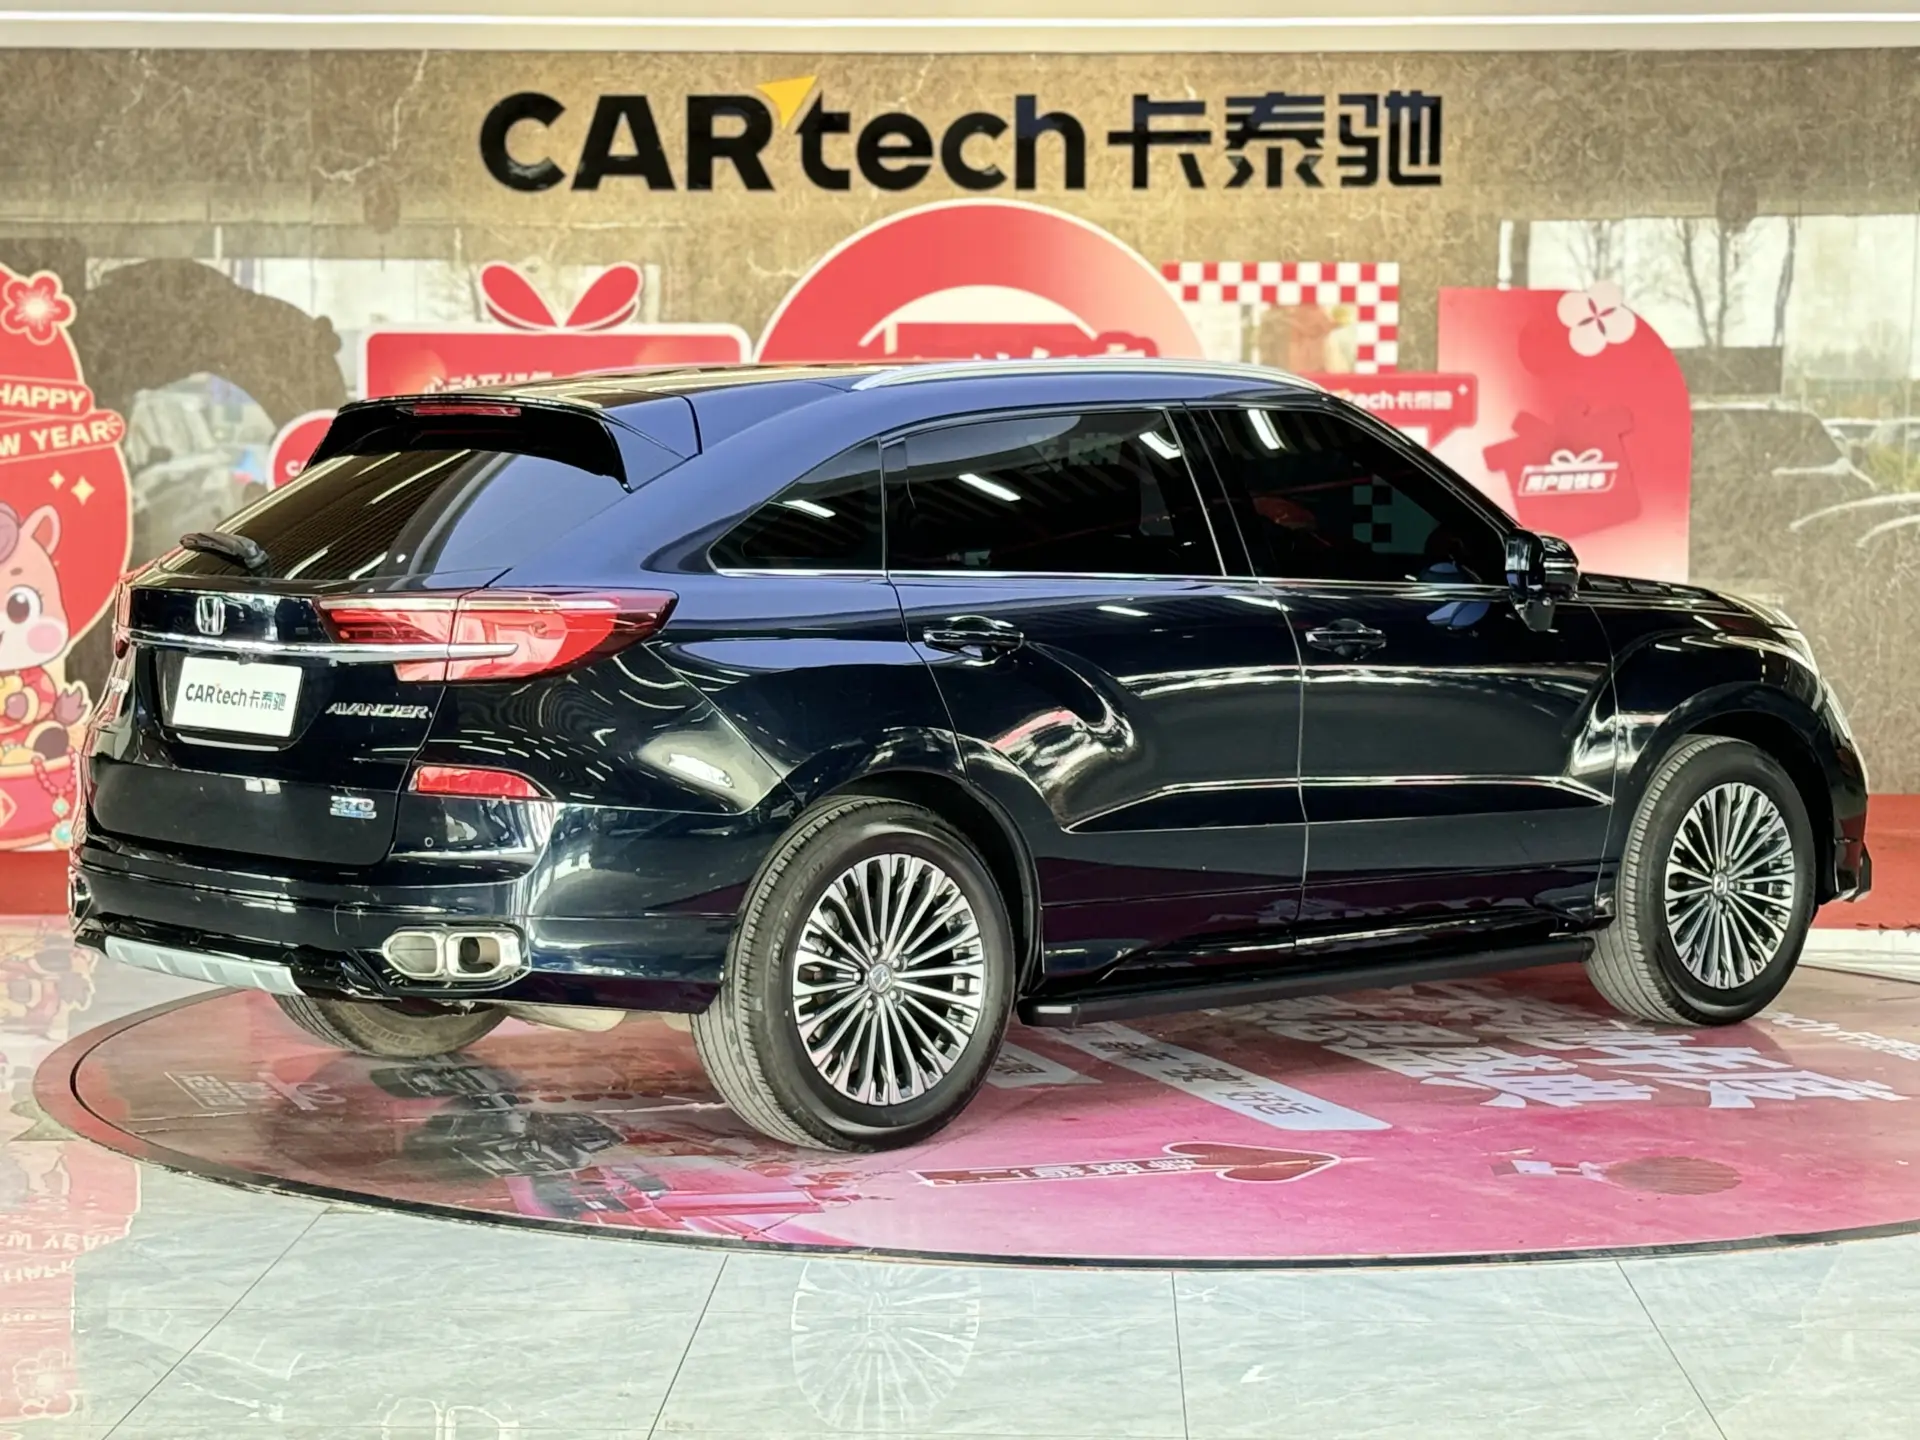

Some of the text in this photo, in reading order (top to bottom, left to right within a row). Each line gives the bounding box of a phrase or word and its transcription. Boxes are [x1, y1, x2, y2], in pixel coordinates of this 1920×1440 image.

[480, 90, 1443, 192] CARtech 卡泰驰
[0, 382, 87, 413] HAPPY
[29, 420, 112, 452] YEAR
[185, 683, 247, 707] CARtech
[324, 702, 429, 719] AVANCIER
